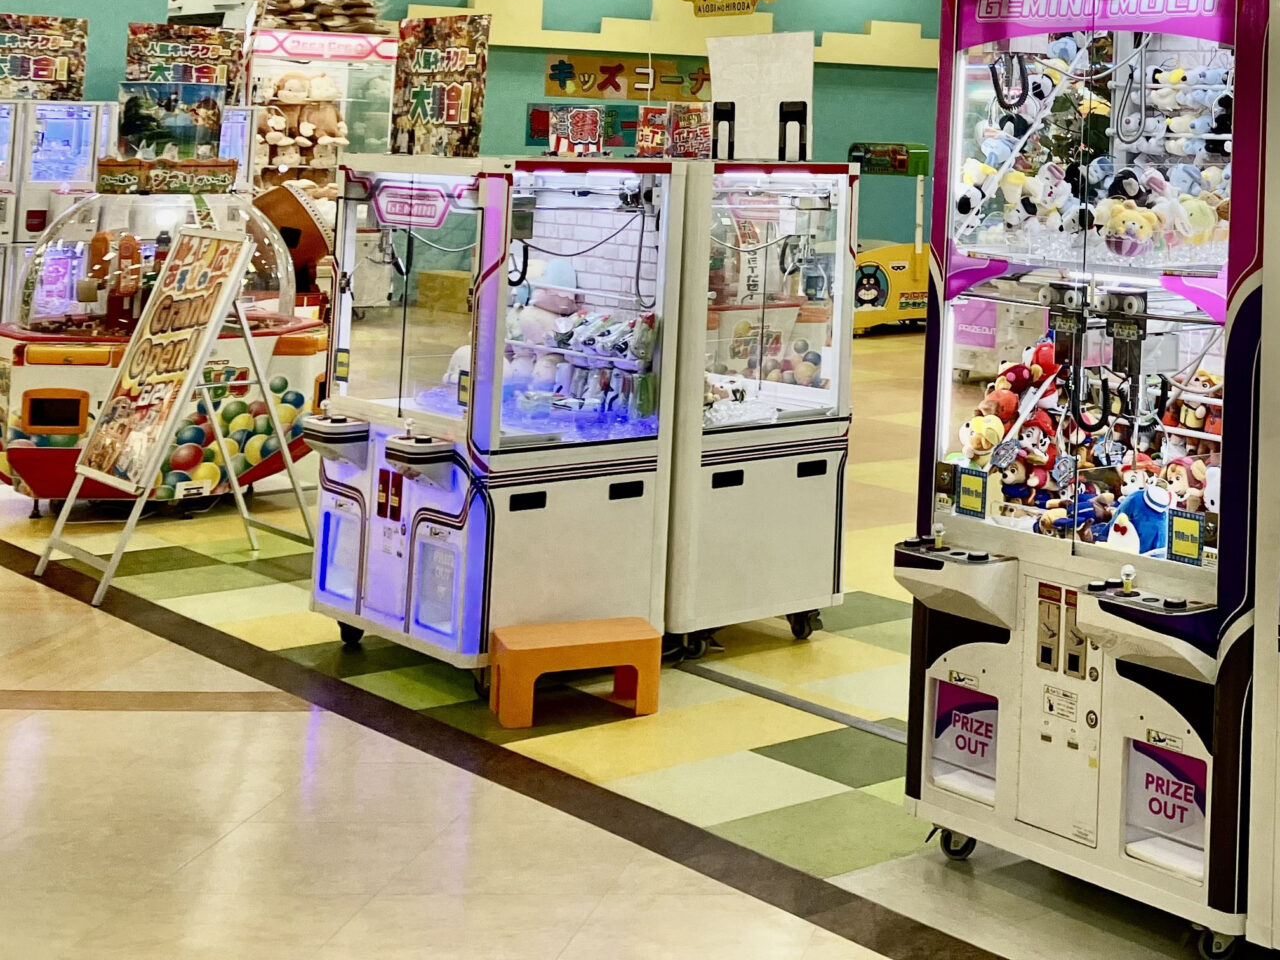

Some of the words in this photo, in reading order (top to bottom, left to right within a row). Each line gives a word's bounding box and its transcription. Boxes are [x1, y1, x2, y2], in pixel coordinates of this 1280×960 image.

[150, 282, 223, 336] Grand
[952, 710, 994, 740] PRIZE
[954, 733, 989, 758] OUT
[1145, 772, 1195, 804] PRIZE
[1147, 796, 1189, 824] OUT
